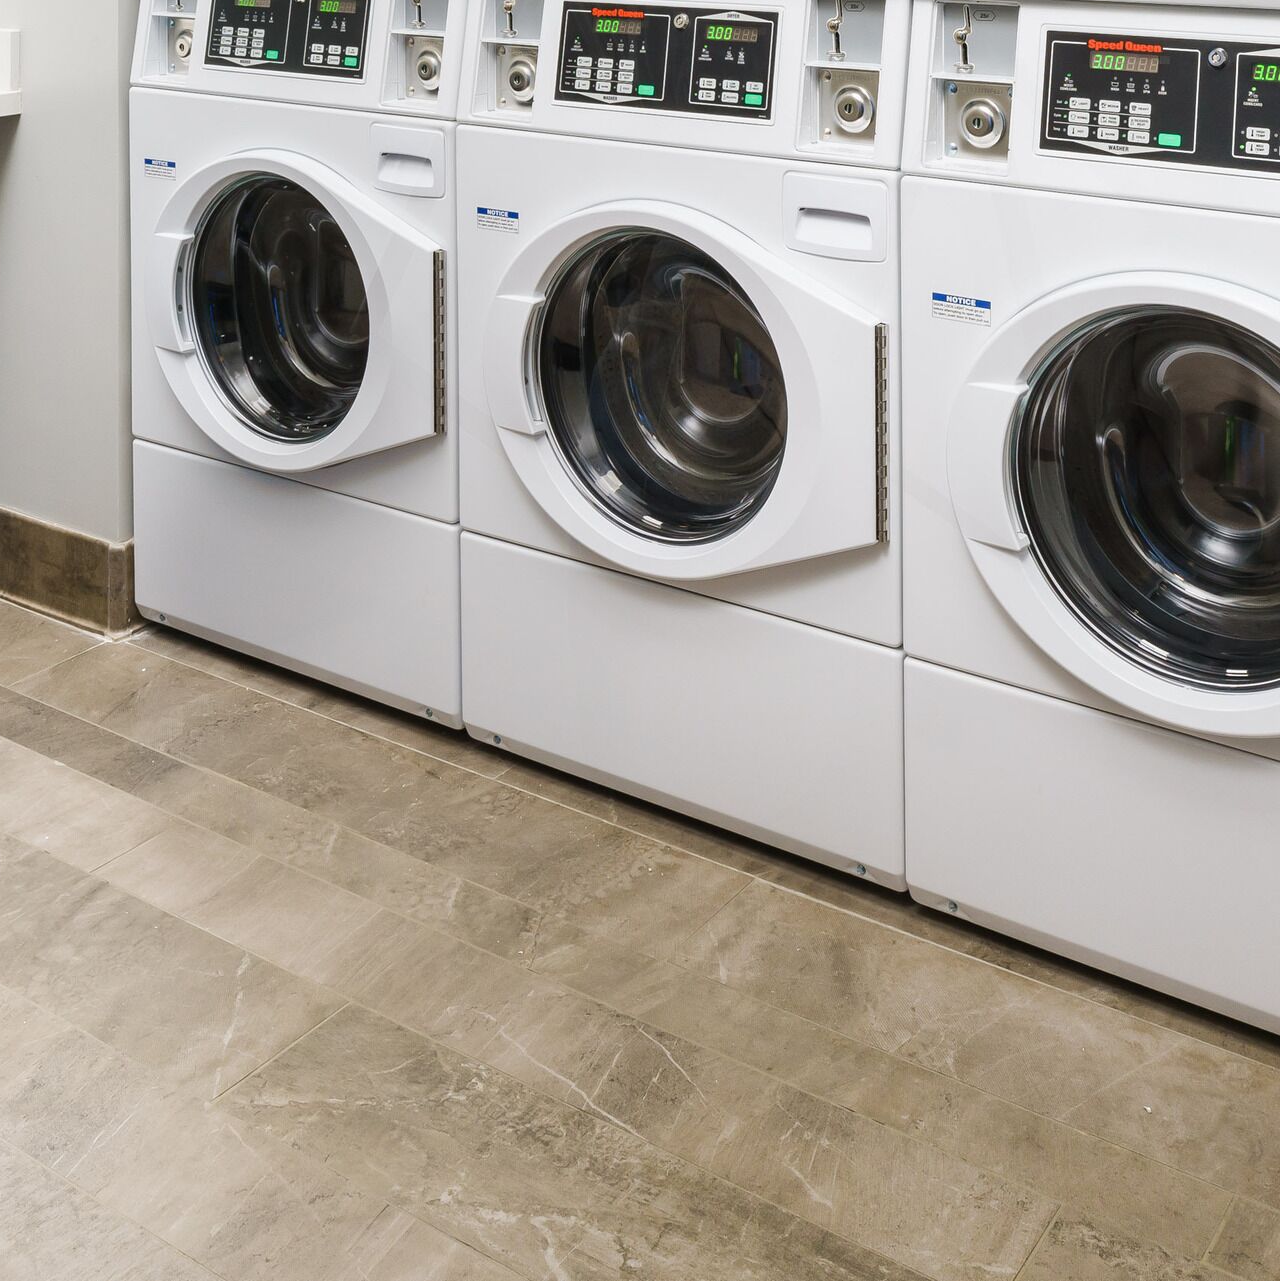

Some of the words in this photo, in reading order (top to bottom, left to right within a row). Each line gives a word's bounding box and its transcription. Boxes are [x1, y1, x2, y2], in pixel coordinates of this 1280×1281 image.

[592, 8, 617, 17] Speed
[618, 9, 644, 18] Queen
[596, 20, 619, 32] 3.00
[706, 26, 732, 40] 3.00
[1088, 39, 1123, 50] Speed
[1125, 41, 1163, 53] Queen
[1092, 54, 1126, 70] 3.00
[487, 210, 508, 218] NOTICE
[946, 295, 976, 306] NOTICE
